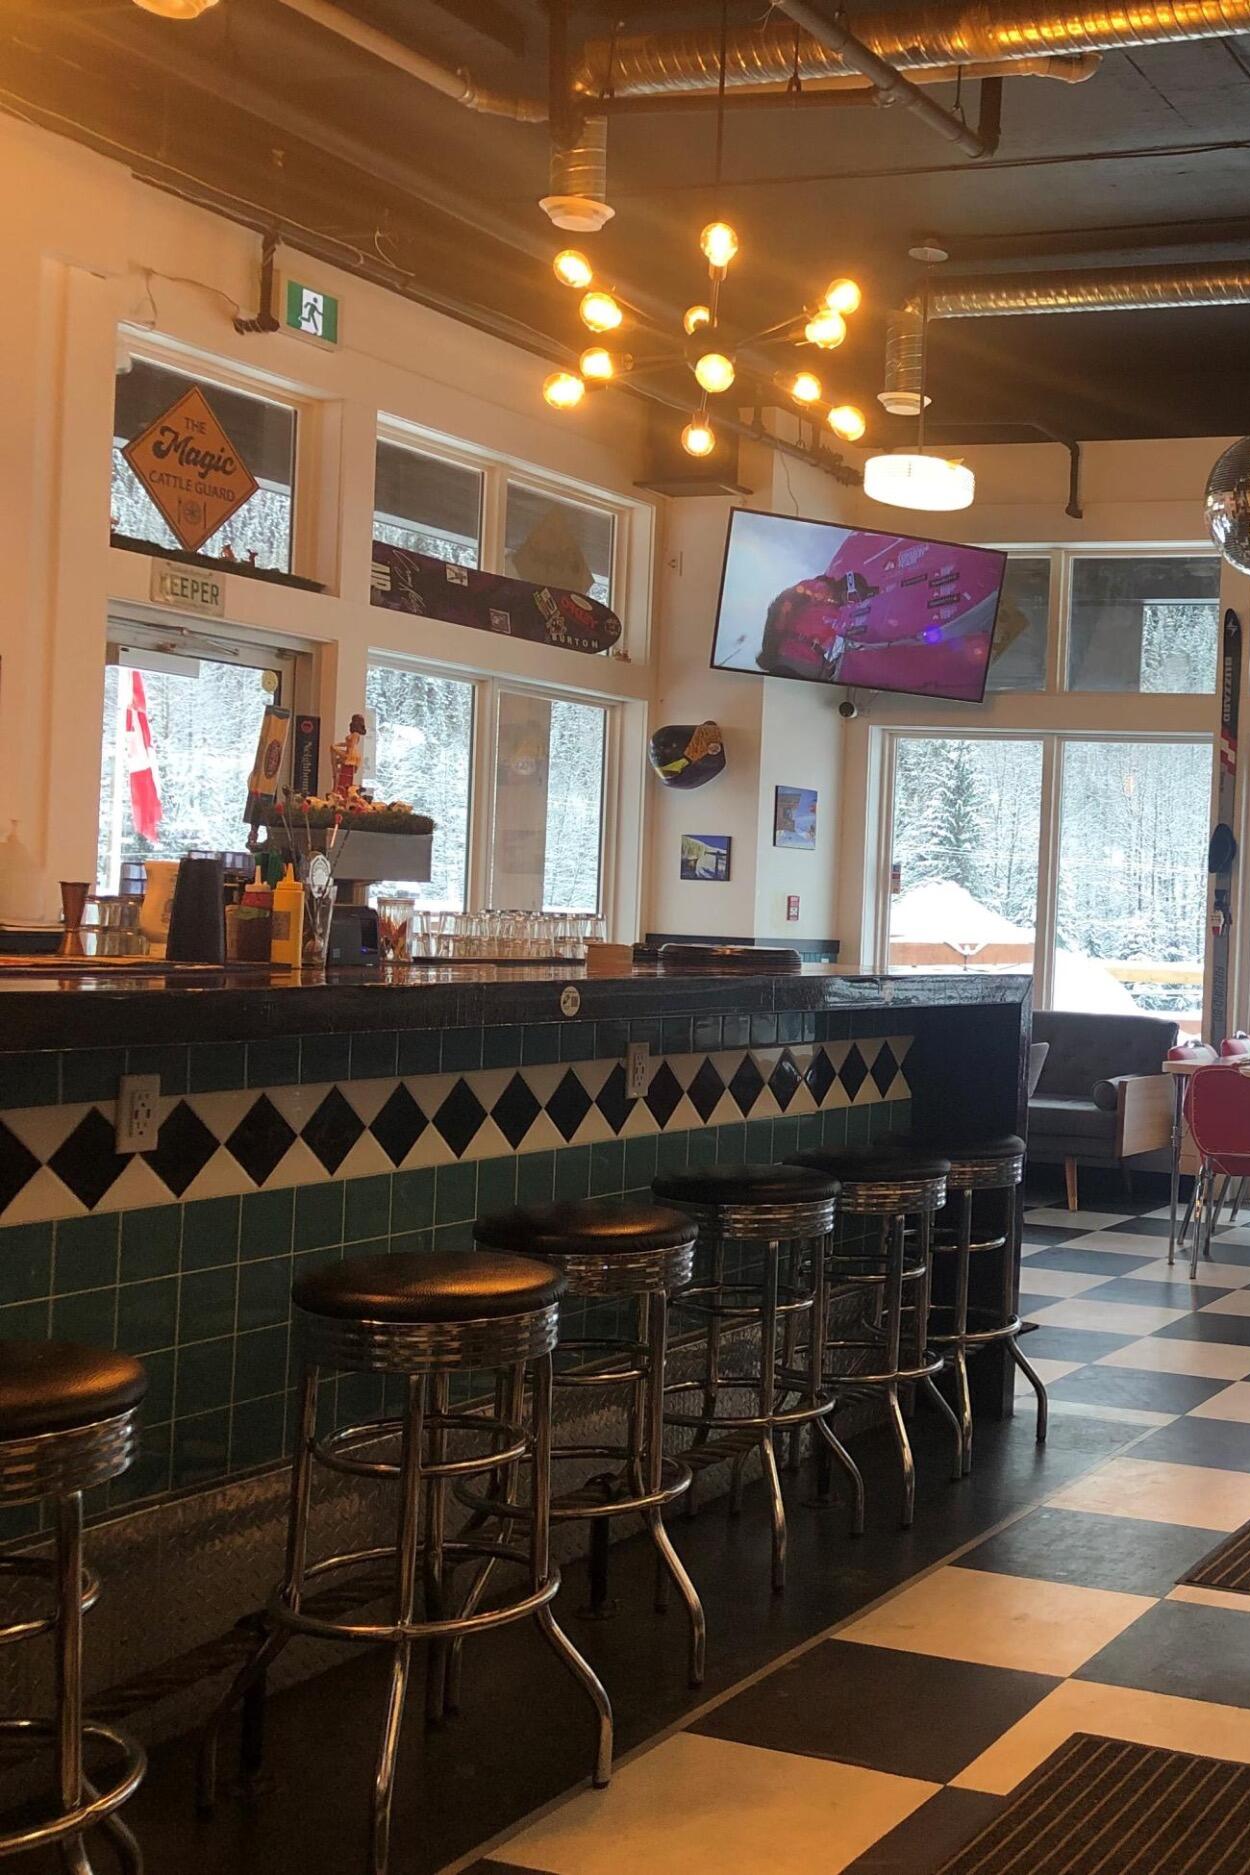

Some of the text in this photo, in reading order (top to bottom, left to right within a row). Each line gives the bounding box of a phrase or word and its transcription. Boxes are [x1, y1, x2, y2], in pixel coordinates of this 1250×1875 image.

[184, 417, 208, 435] THE
[152, 425, 237, 480] Magic
[148, 469, 236, 502] CATTLE GUARD
[1223, 656, 1233, 722] BLIZZARD
